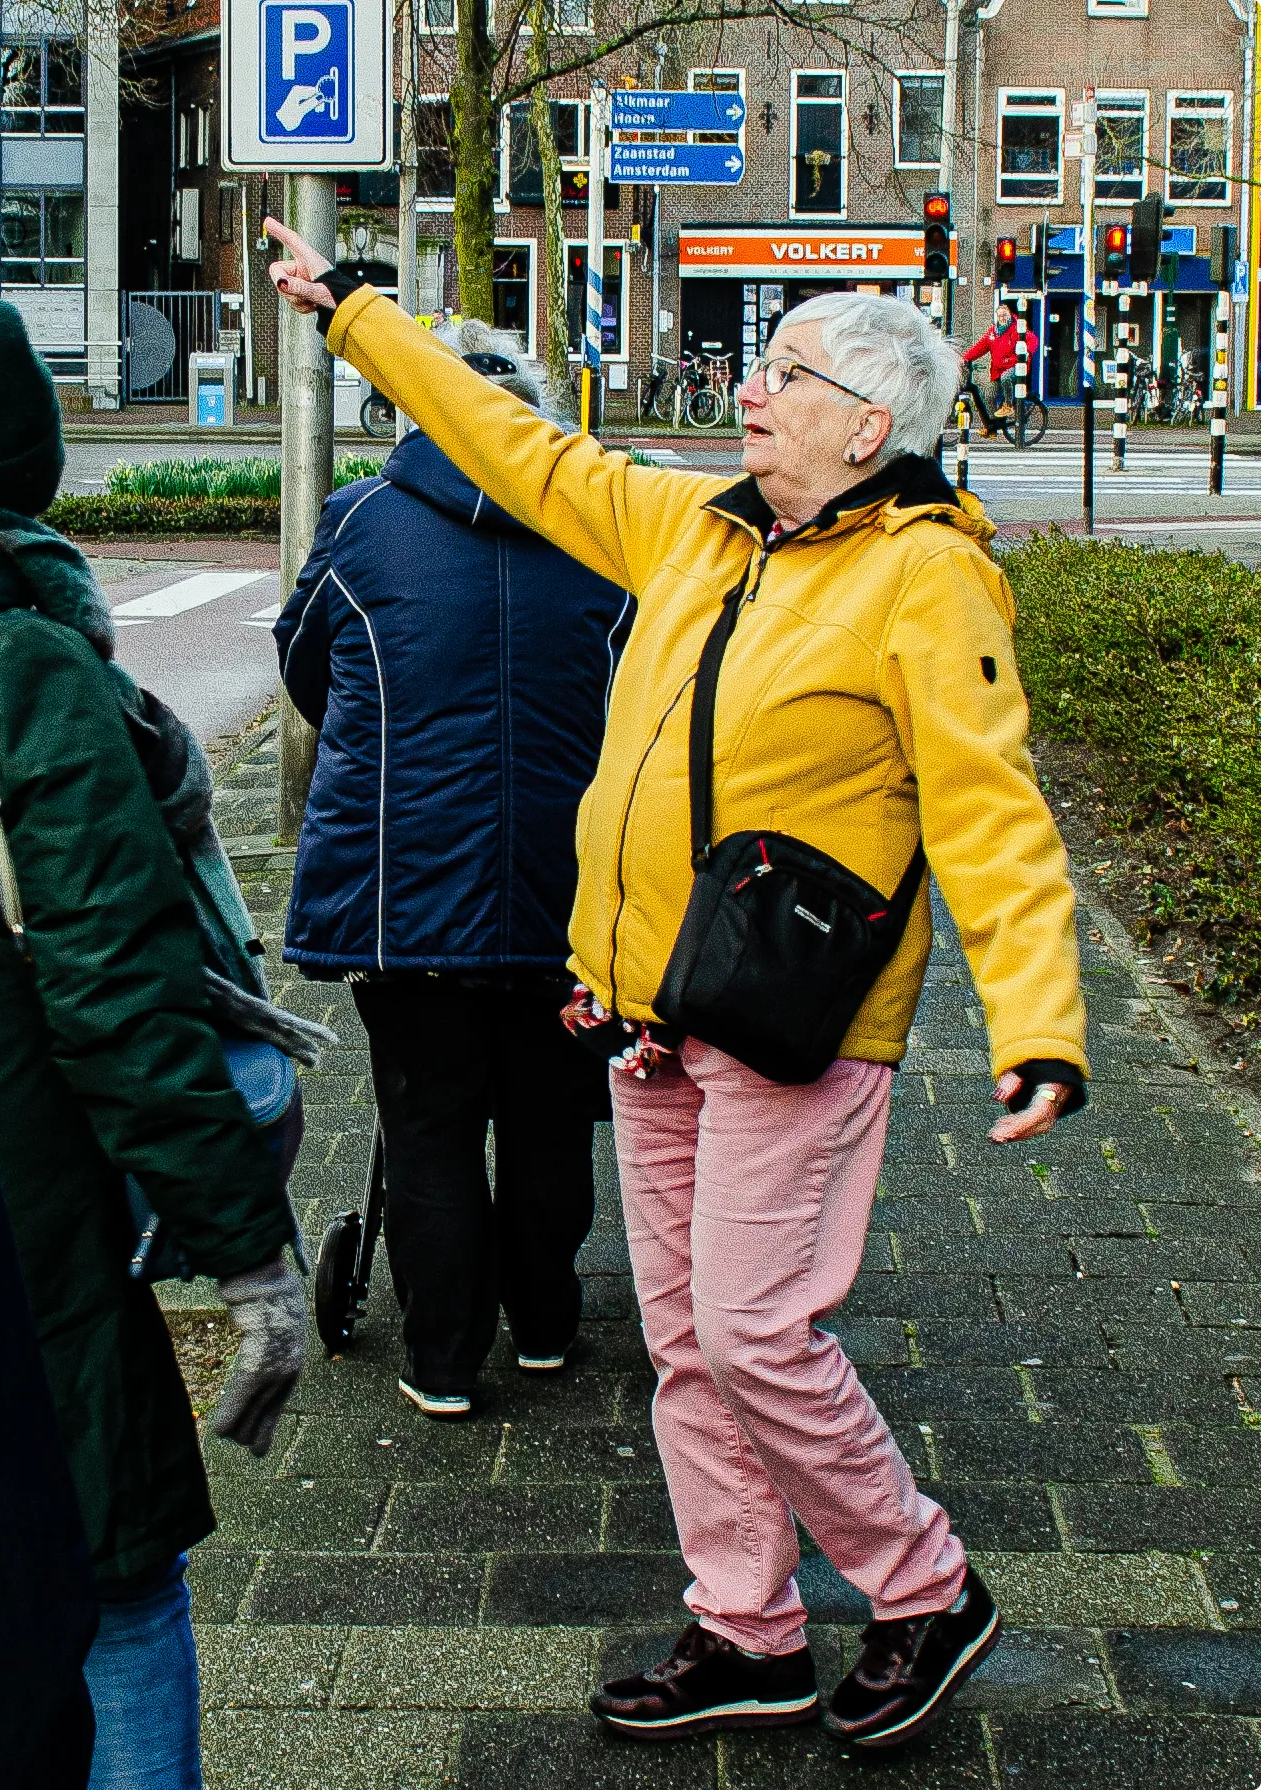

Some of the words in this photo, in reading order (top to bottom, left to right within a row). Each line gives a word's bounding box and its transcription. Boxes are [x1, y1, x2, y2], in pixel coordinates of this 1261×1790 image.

[281, 9, 332, 81] P
[616, 95, 671, 108] Alkmaar
[614, 147, 675, 160] Zaanstad
[613, 164, 690, 177] Amsterdam
[687, 246, 735, 256] VOLKERT
[770, 243, 884, 260] VOLKERT
